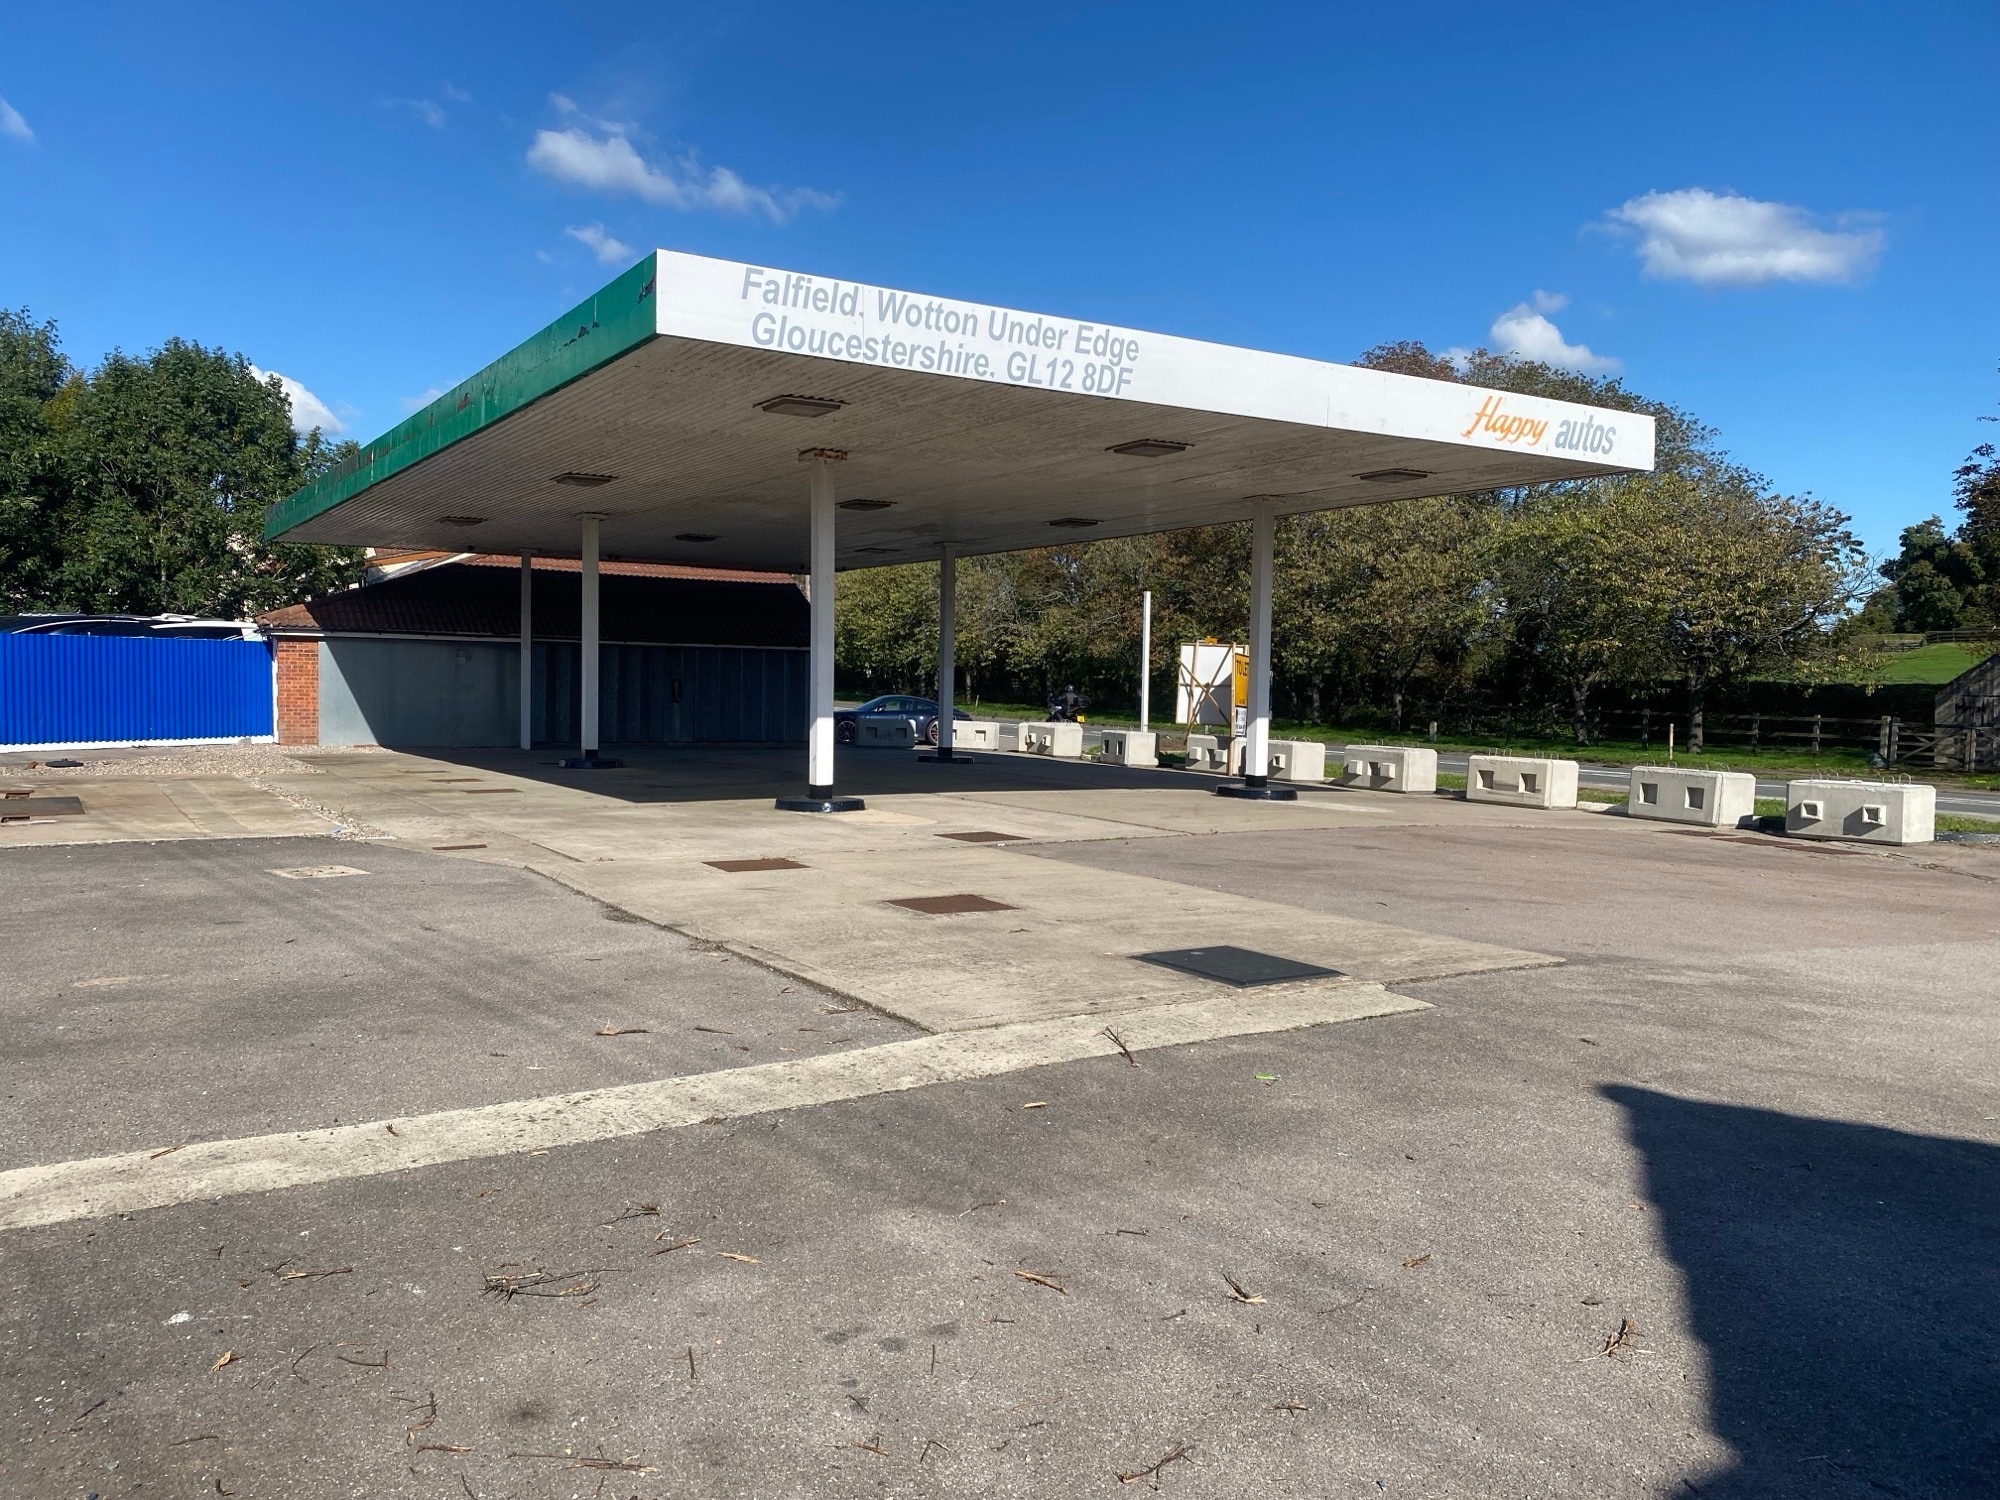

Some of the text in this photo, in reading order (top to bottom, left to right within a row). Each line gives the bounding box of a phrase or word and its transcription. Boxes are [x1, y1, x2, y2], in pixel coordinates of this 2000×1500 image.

[877, 289, 979, 338] Wotton
[988, 309, 1069, 351] Under
[1074, 323, 1140, 368] Edge
[1006, 350, 1075, 390] GL12
[1081, 362, 1134, 396] 8DF
[1461, 395, 1617, 455] Happy autos
